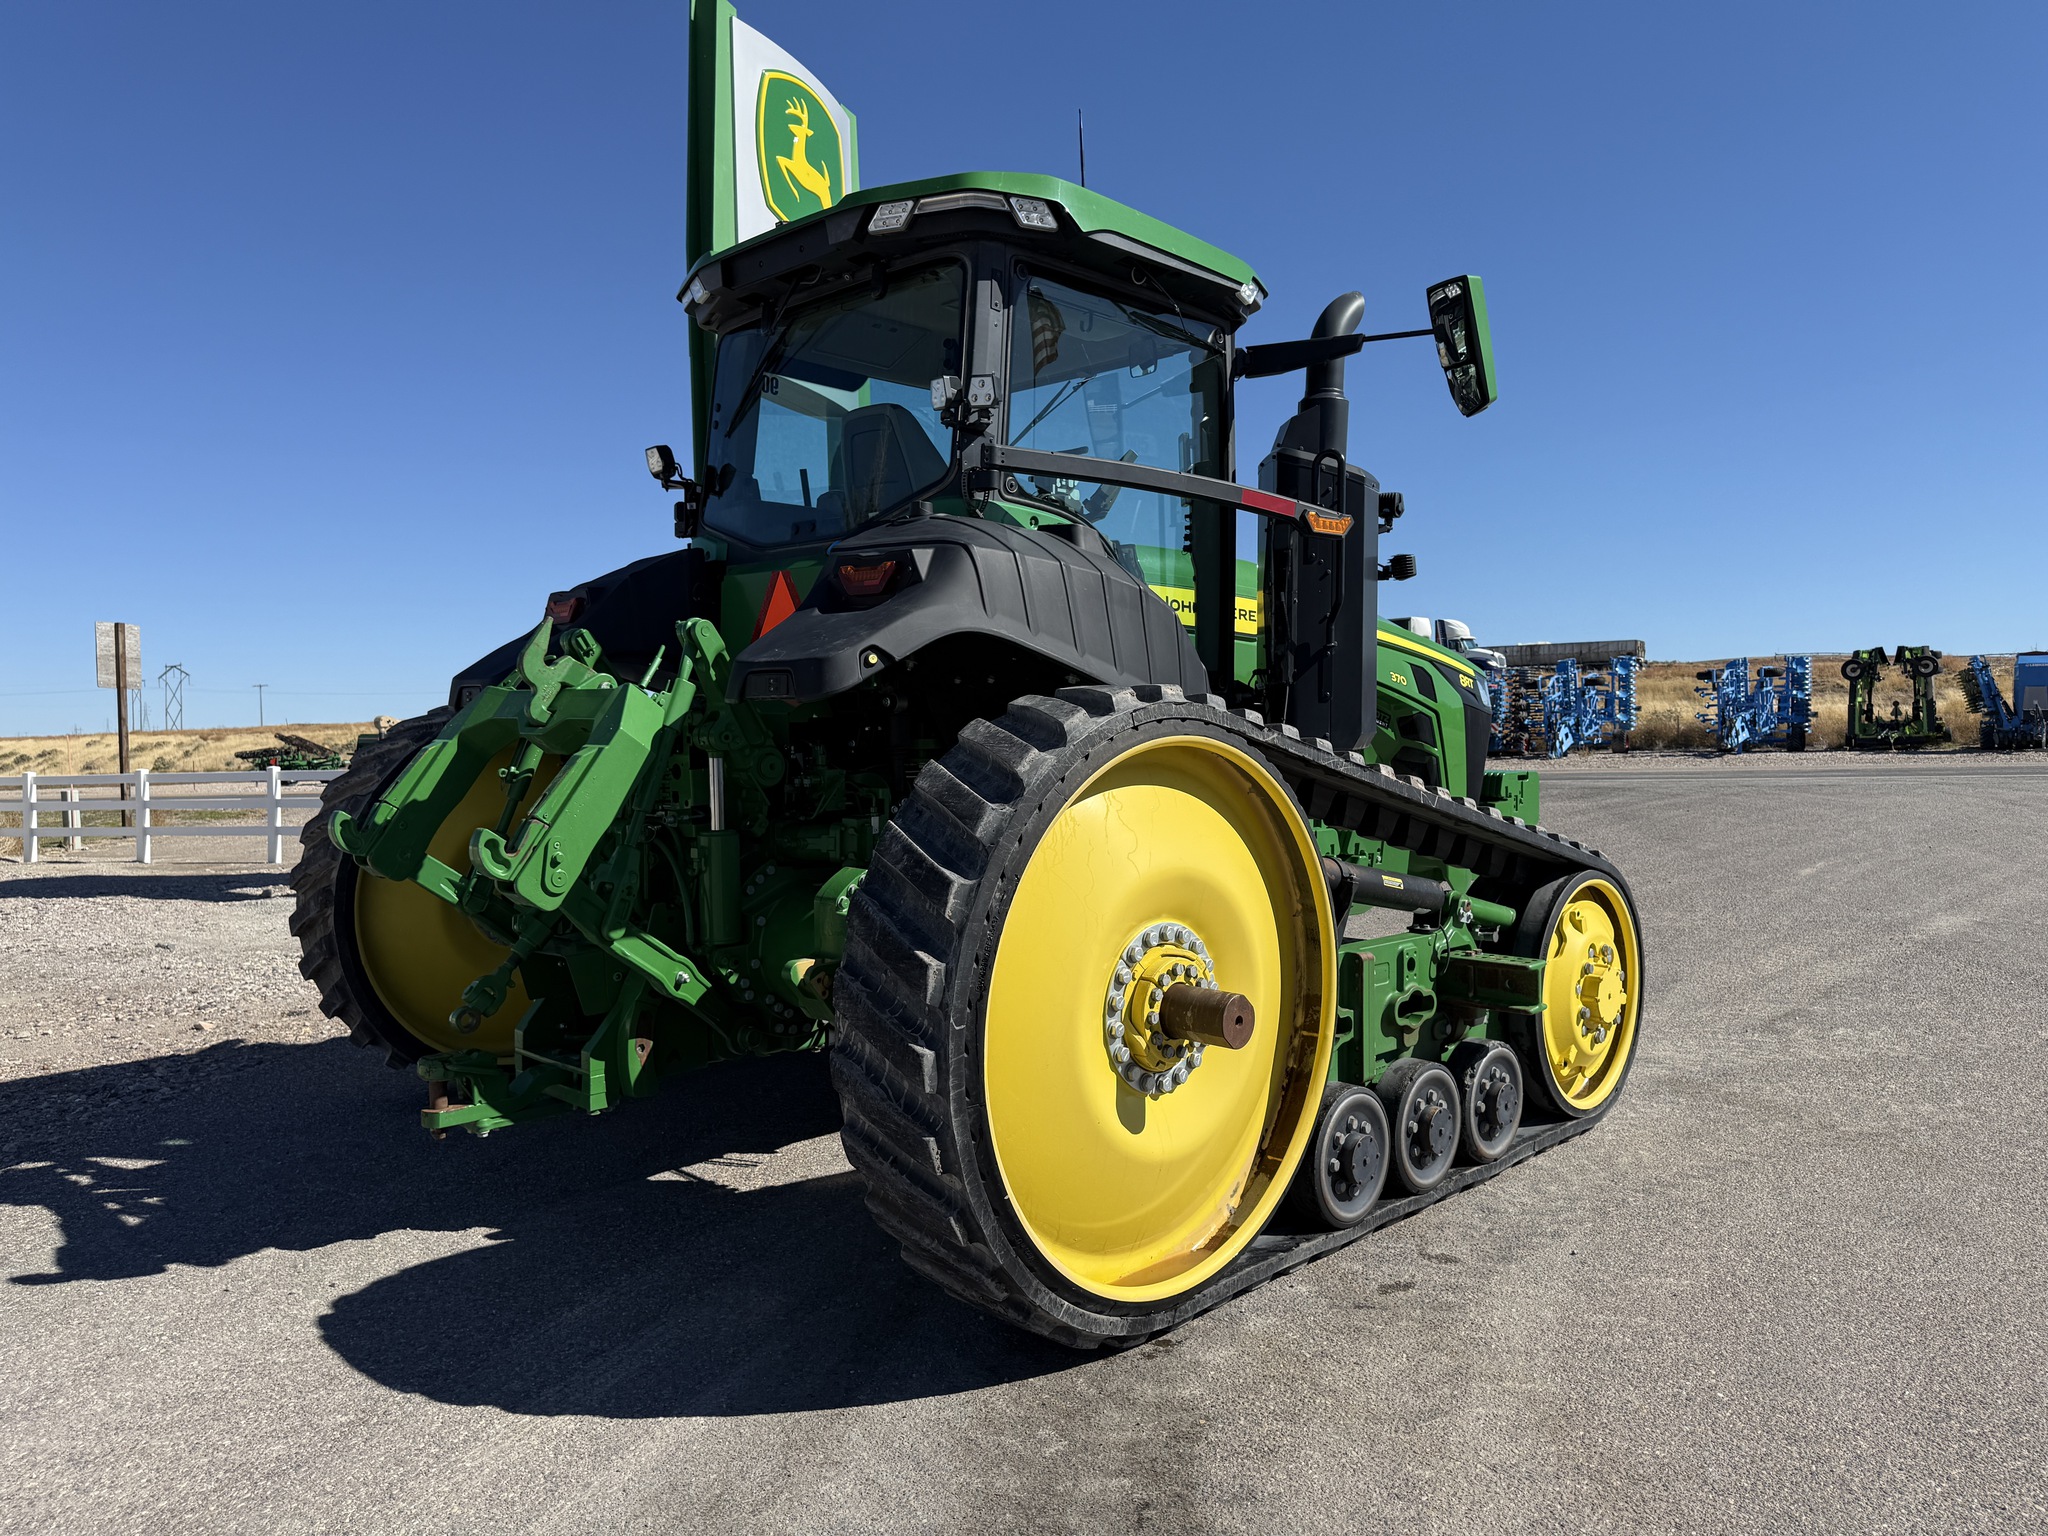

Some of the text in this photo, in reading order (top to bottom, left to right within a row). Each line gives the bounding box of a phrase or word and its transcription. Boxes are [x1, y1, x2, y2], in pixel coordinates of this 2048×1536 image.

[1166, 596, 1196, 613] JOH
[1390, 672, 1407, 686] 370
[1459, 674, 1474, 689] 8RT
